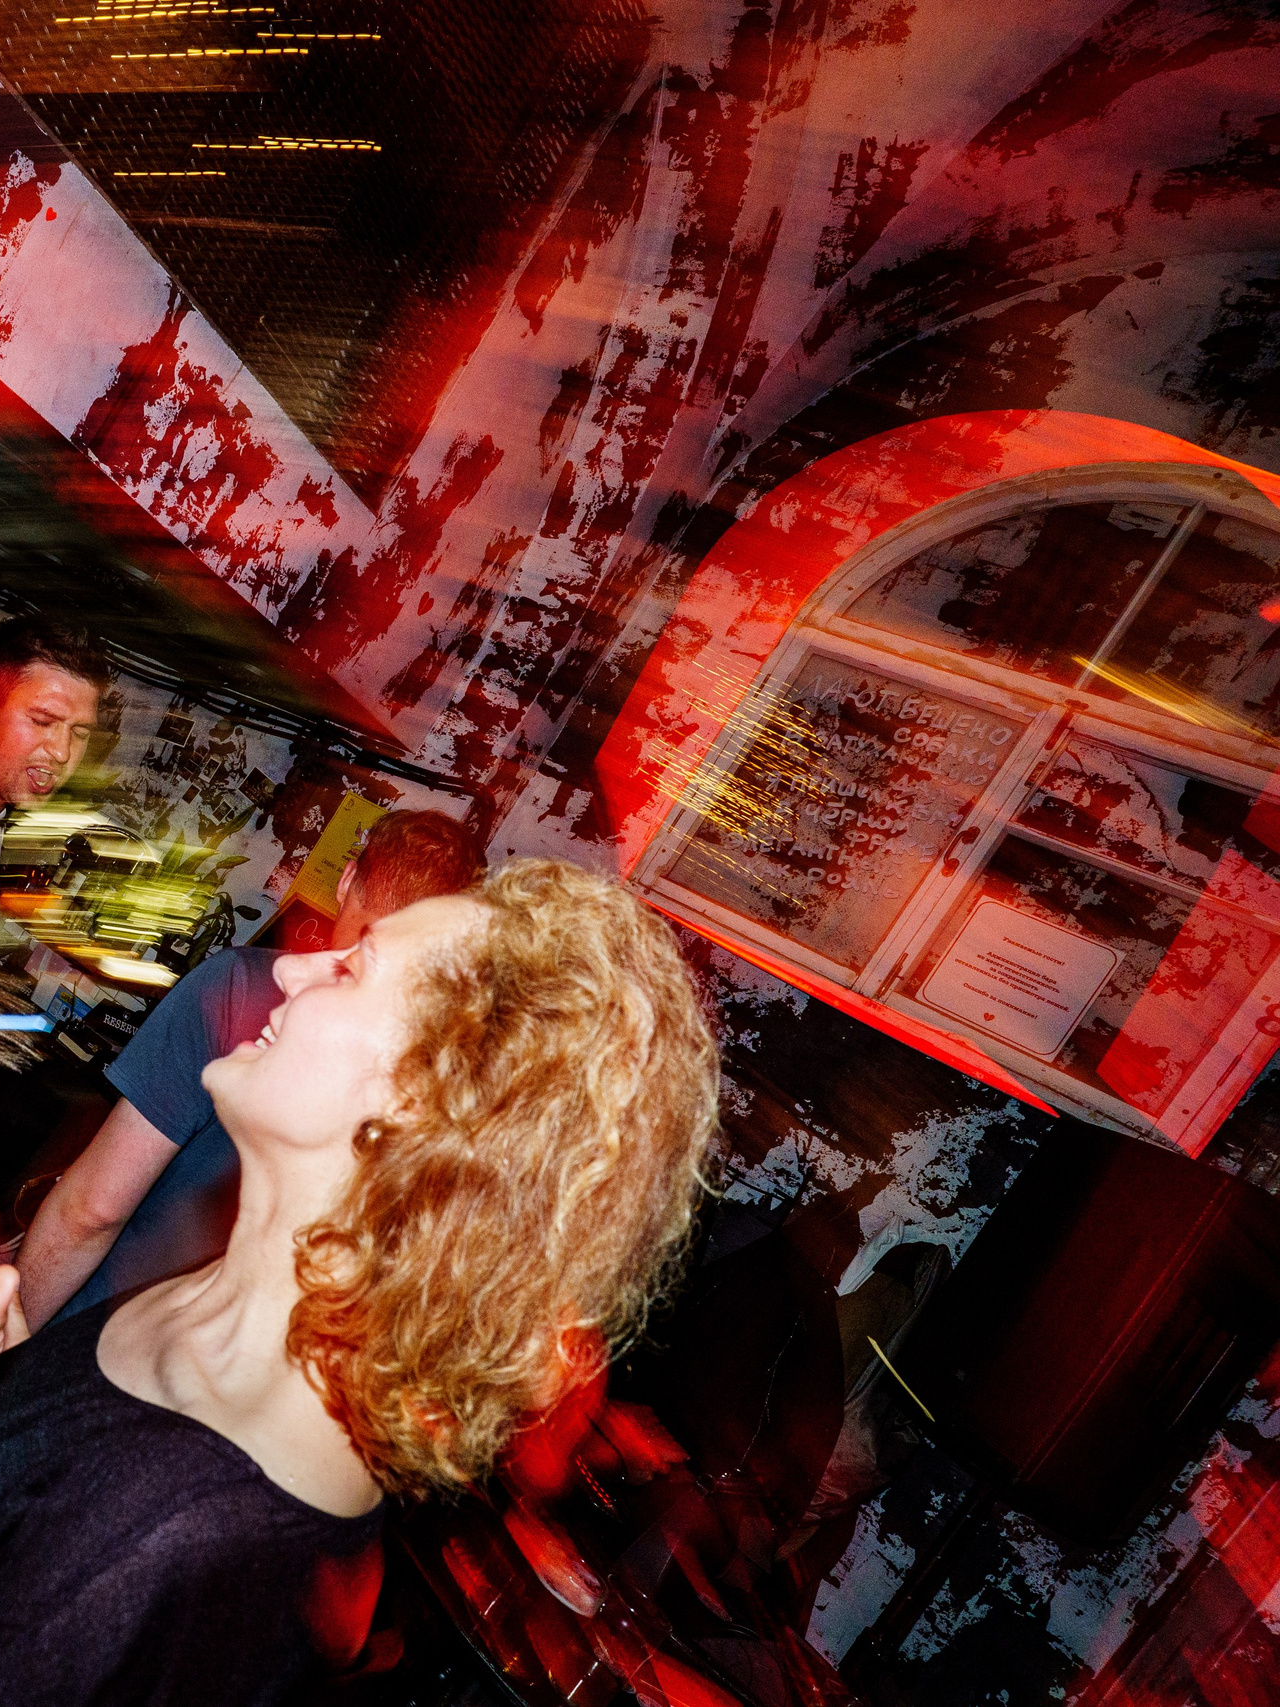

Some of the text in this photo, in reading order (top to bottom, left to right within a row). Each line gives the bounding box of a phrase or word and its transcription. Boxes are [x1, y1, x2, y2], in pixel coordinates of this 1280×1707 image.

[798, 674, 1013, 746] ЛАЮТ БЕШЕНО
[893, 727, 997, 770] СОБАКИ
[986, 951, 1057, 985] Администрация бара
[1002, 936, 1066, 967] Уважаемые гости!
[954, 958, 1070, 1013] оставленных без присмотра вещей.
[997, 970, 1039, 991] сохранность
[1004, 966, 1060, 993] ответственность
[963, 982, 989, 998] Спасибо
[997, 998, 1038, 1020] понимание!
